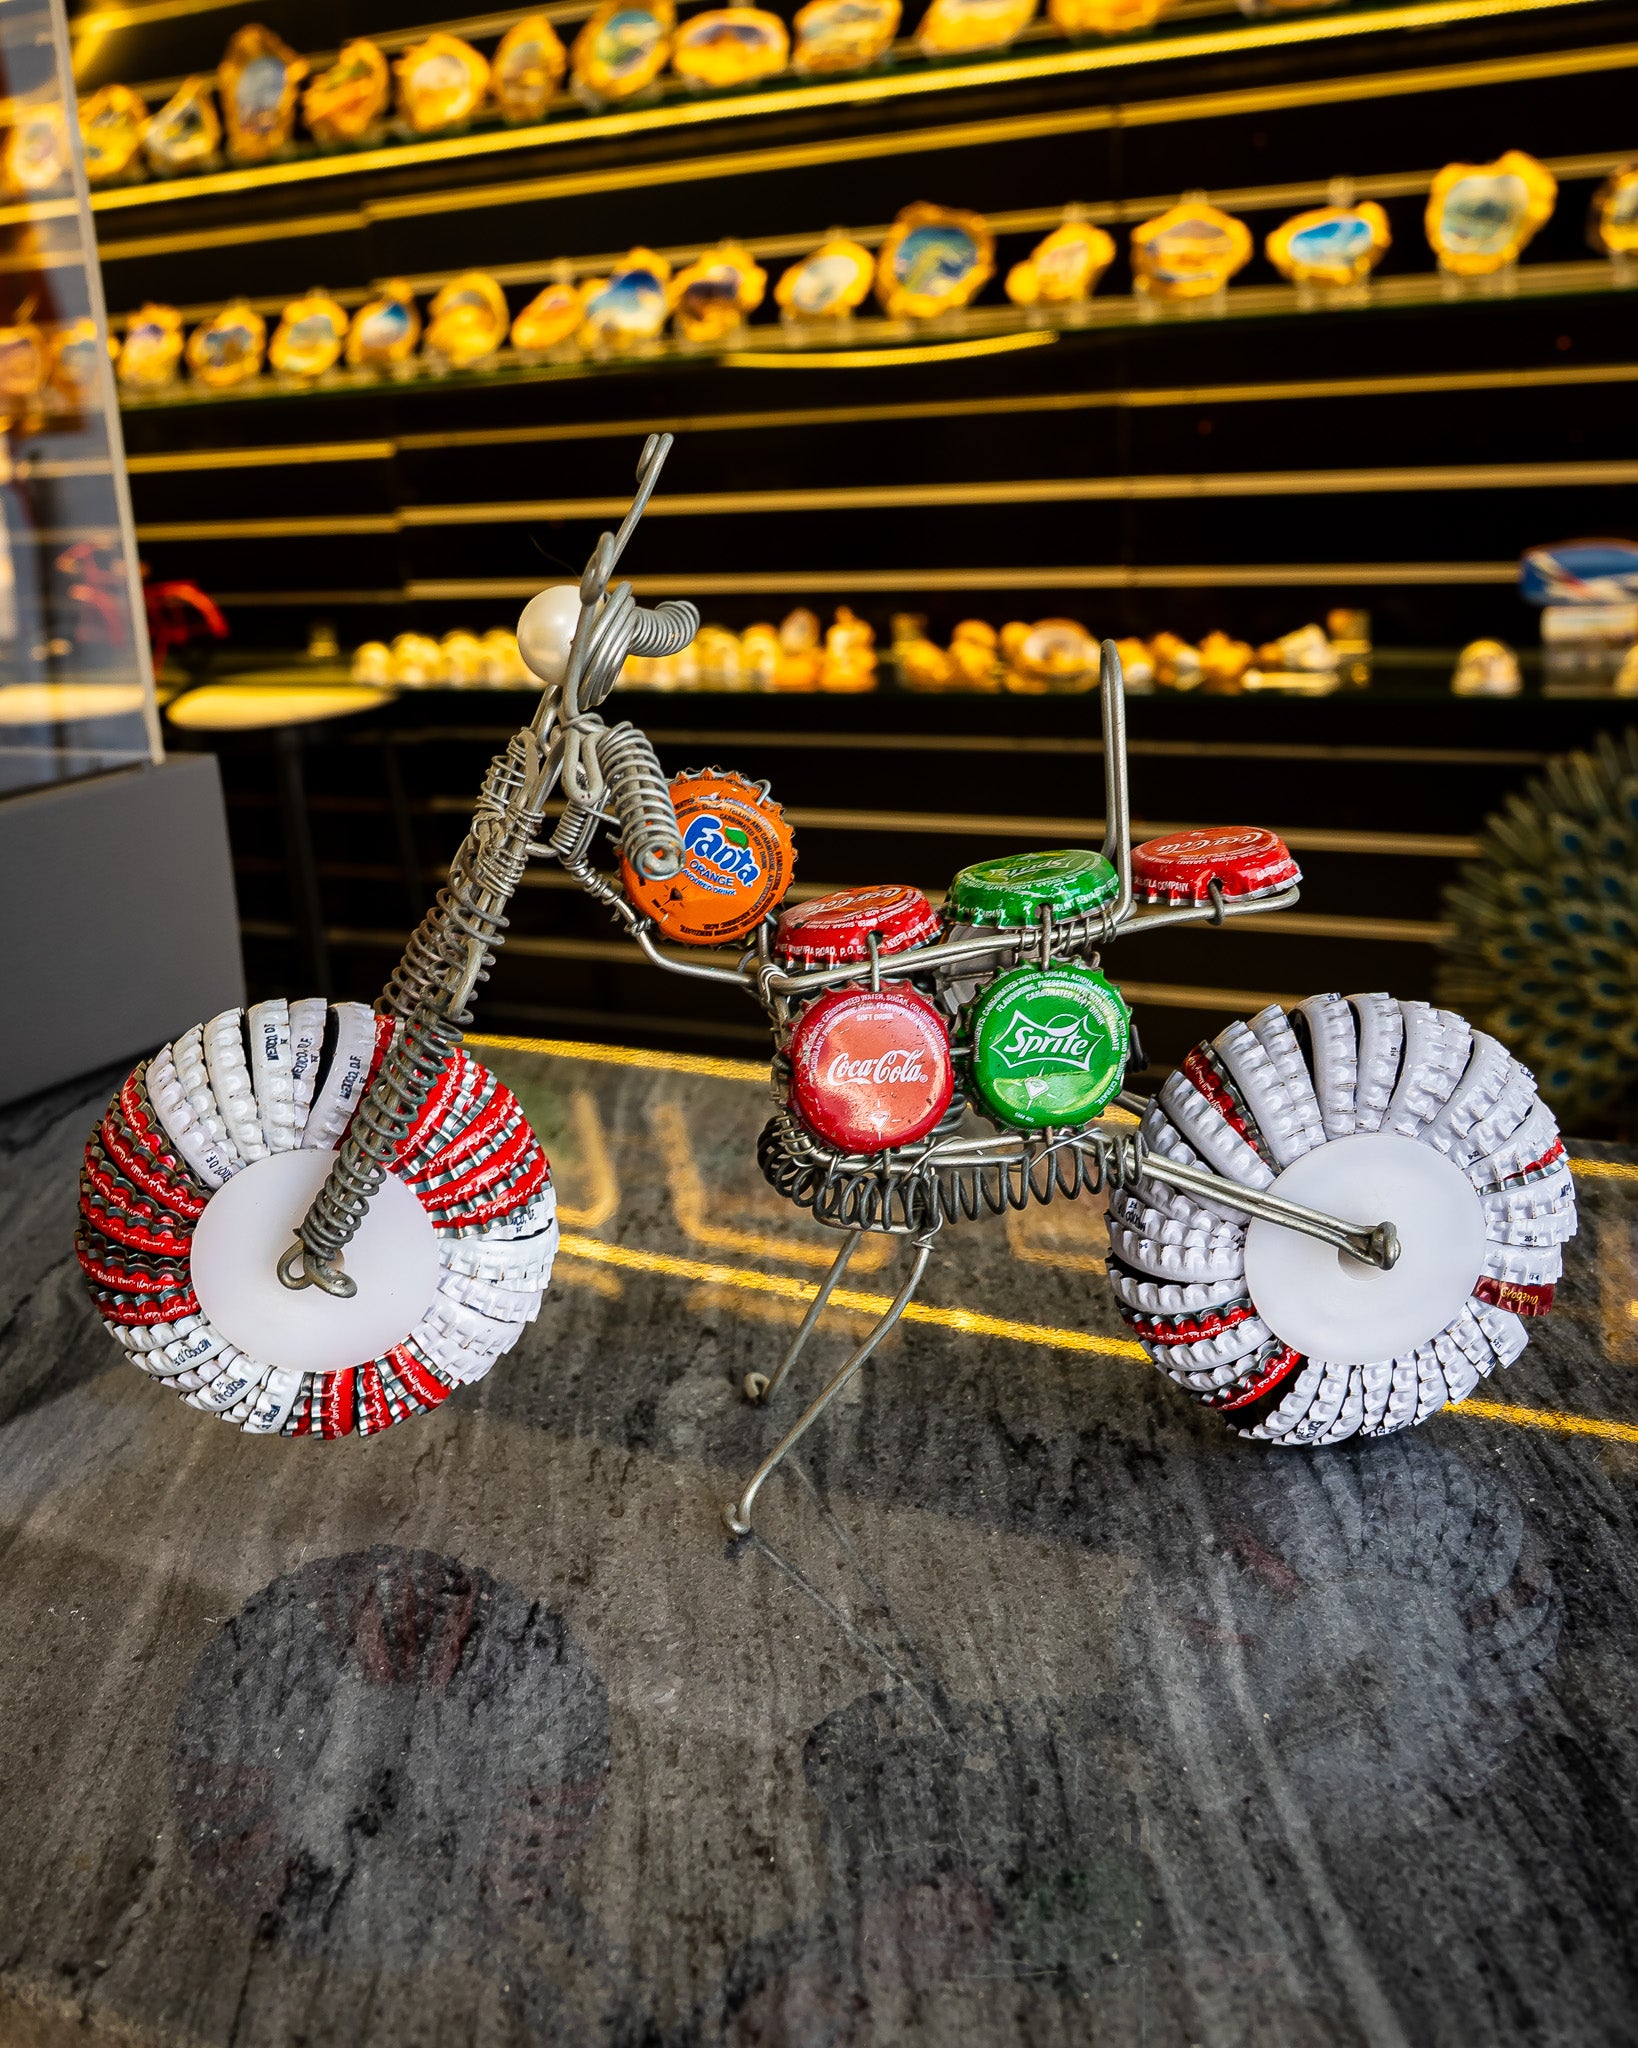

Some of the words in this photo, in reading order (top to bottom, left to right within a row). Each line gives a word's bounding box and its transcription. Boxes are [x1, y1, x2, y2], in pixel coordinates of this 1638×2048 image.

[684, 815, 759, 886] Fanta
[1155, 832, 1263, 856] Coca-Cola
[682, 868, 712, 891] AVOURED
[690, 860, 734, 886] ORANGE
[856, 1013, 873, 1022] SOFT
[1087, 1003, 1105, 1026] DRINK
[1004, 1026, 1089, 1058] Sprite
[827, 1049, 926, 1086] Coca-Cola
